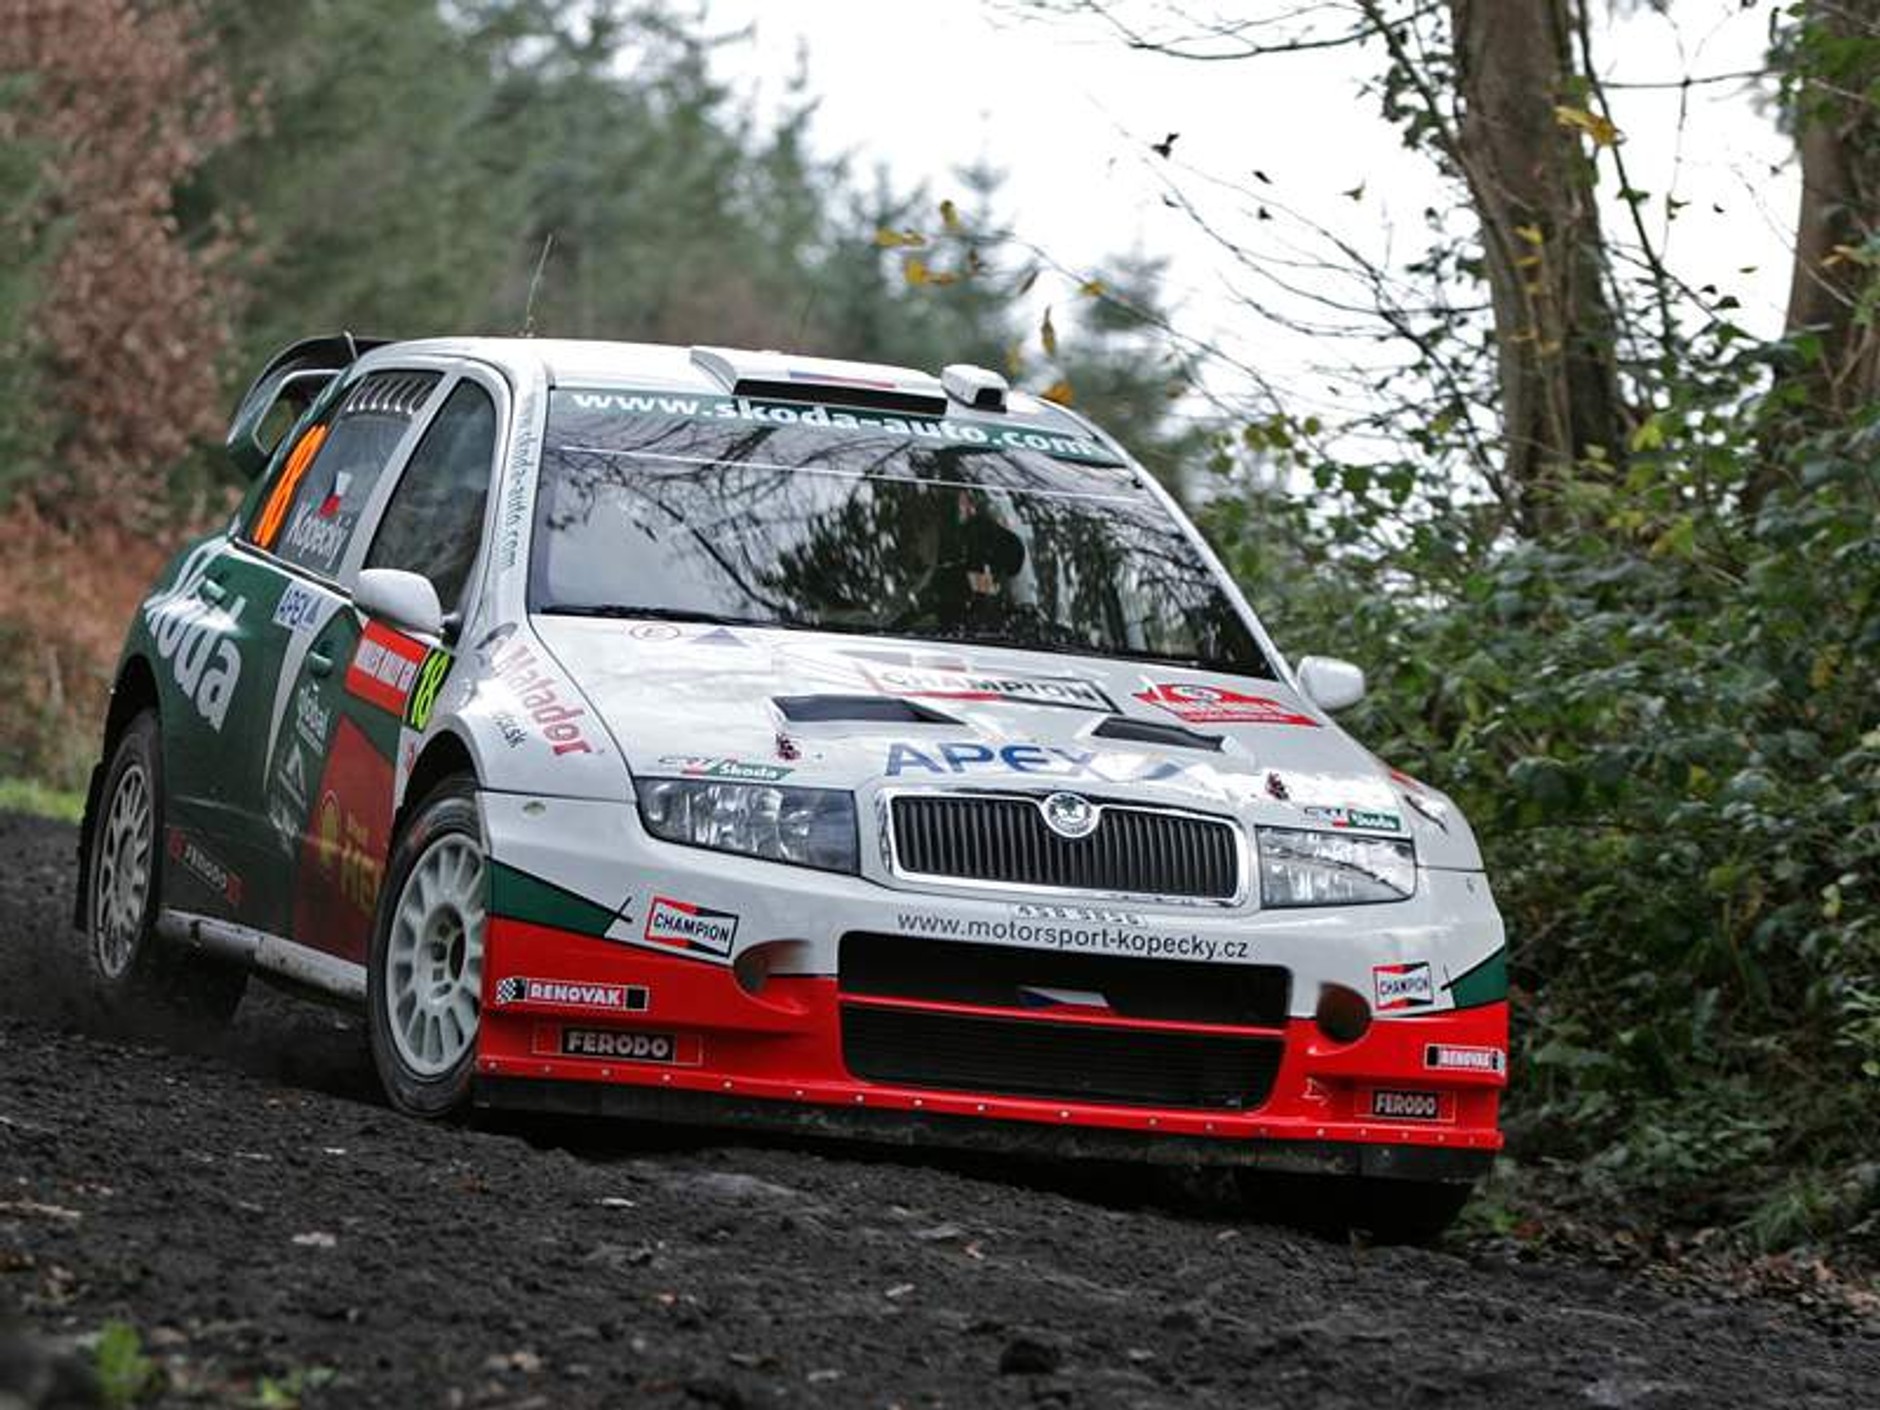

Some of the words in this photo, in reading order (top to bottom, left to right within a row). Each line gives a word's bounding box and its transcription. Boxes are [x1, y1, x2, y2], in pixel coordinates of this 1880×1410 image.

[572, 391, 1095, 457] www.skoda-auto.com
[411, 650, 450, 730] 18
[493, 645, 593, 756] Matador
[653, 911, 731, 943] CHAMPION
[898, 912, 1248, 959] www.motorsport-kopecky.cz
[529, 981, 624, 1007] RENOVAK
[567, 1031, 670, 1058] FERODO
[1375, 1091, 1437, 1116] FERODO
